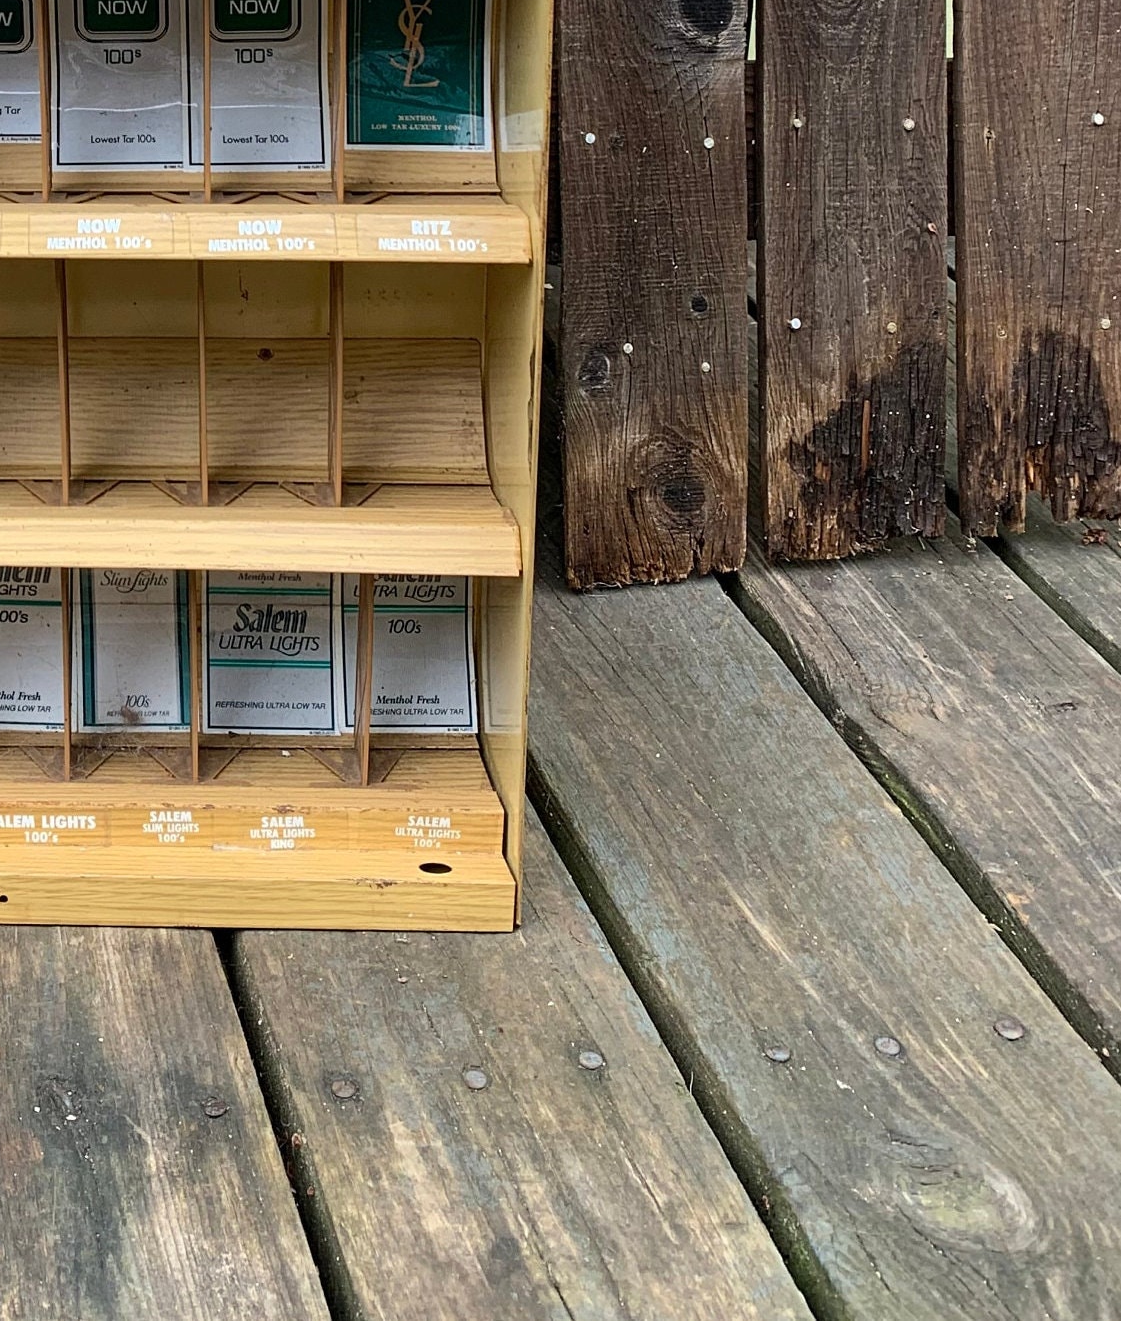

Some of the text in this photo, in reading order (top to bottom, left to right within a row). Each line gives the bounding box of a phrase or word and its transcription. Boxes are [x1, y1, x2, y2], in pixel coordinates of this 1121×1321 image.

[98, 0, 147, 15] NOW
[230, 0, 280, 14] NOW
[4, 106, 21, 115] Tar
[91, 135, 156, 143] Lowest Tar 100s
[222, 135, 289, 144] Lowest Tar 100s
[78, 219, 121, 233] NOW
[239, 220, 282, 234] NOW
[411, 220, 451, 235] RITZ
[47, 237, 152, 249] MENTHOL 100's
[208, 238, 315, 252] MENTHOL 100's
[378, 238, 488, 251] MENTHOL 100's
[238, 572, 302, 581] Menthol Fresh
[404, 585, 455, 602] LIGHTS
[233, 603, 307, 633] Salem
[388, 619, 421, 634] 100's
[219, 635, 320, 656] ULTRA LIGHTS
[18, 691, 41, 701] Fresh
[125, 695, 151, 708] 100's
[376, 695, 440, 705] Menthol Fresh
[18, 704, 35, 712] LOW
[37, 705, 51, 713] TAR
[216, 701, 264, 709] REFRESHING
[311, 702, 326, 710] TAR
[42, 814, 96, 830] LIGHTS
[150, 811, 192, 822] SALEM
[262, 816, 303, 828] SALEM
[408, 815, 451, 827] SALEM
[143, 823, 199, 833] SLIM LIGHTS
[250, 828, 315, 839] ULTRA LIGHTS
[395, 827, 461, 839] ULTRA LIGHTS
[24, 830, 58, 843] 100's
[158, 833, 185, 843] 100's
[271, 840, 294, 849] KING
[413, 838, 441, 848] 100's
